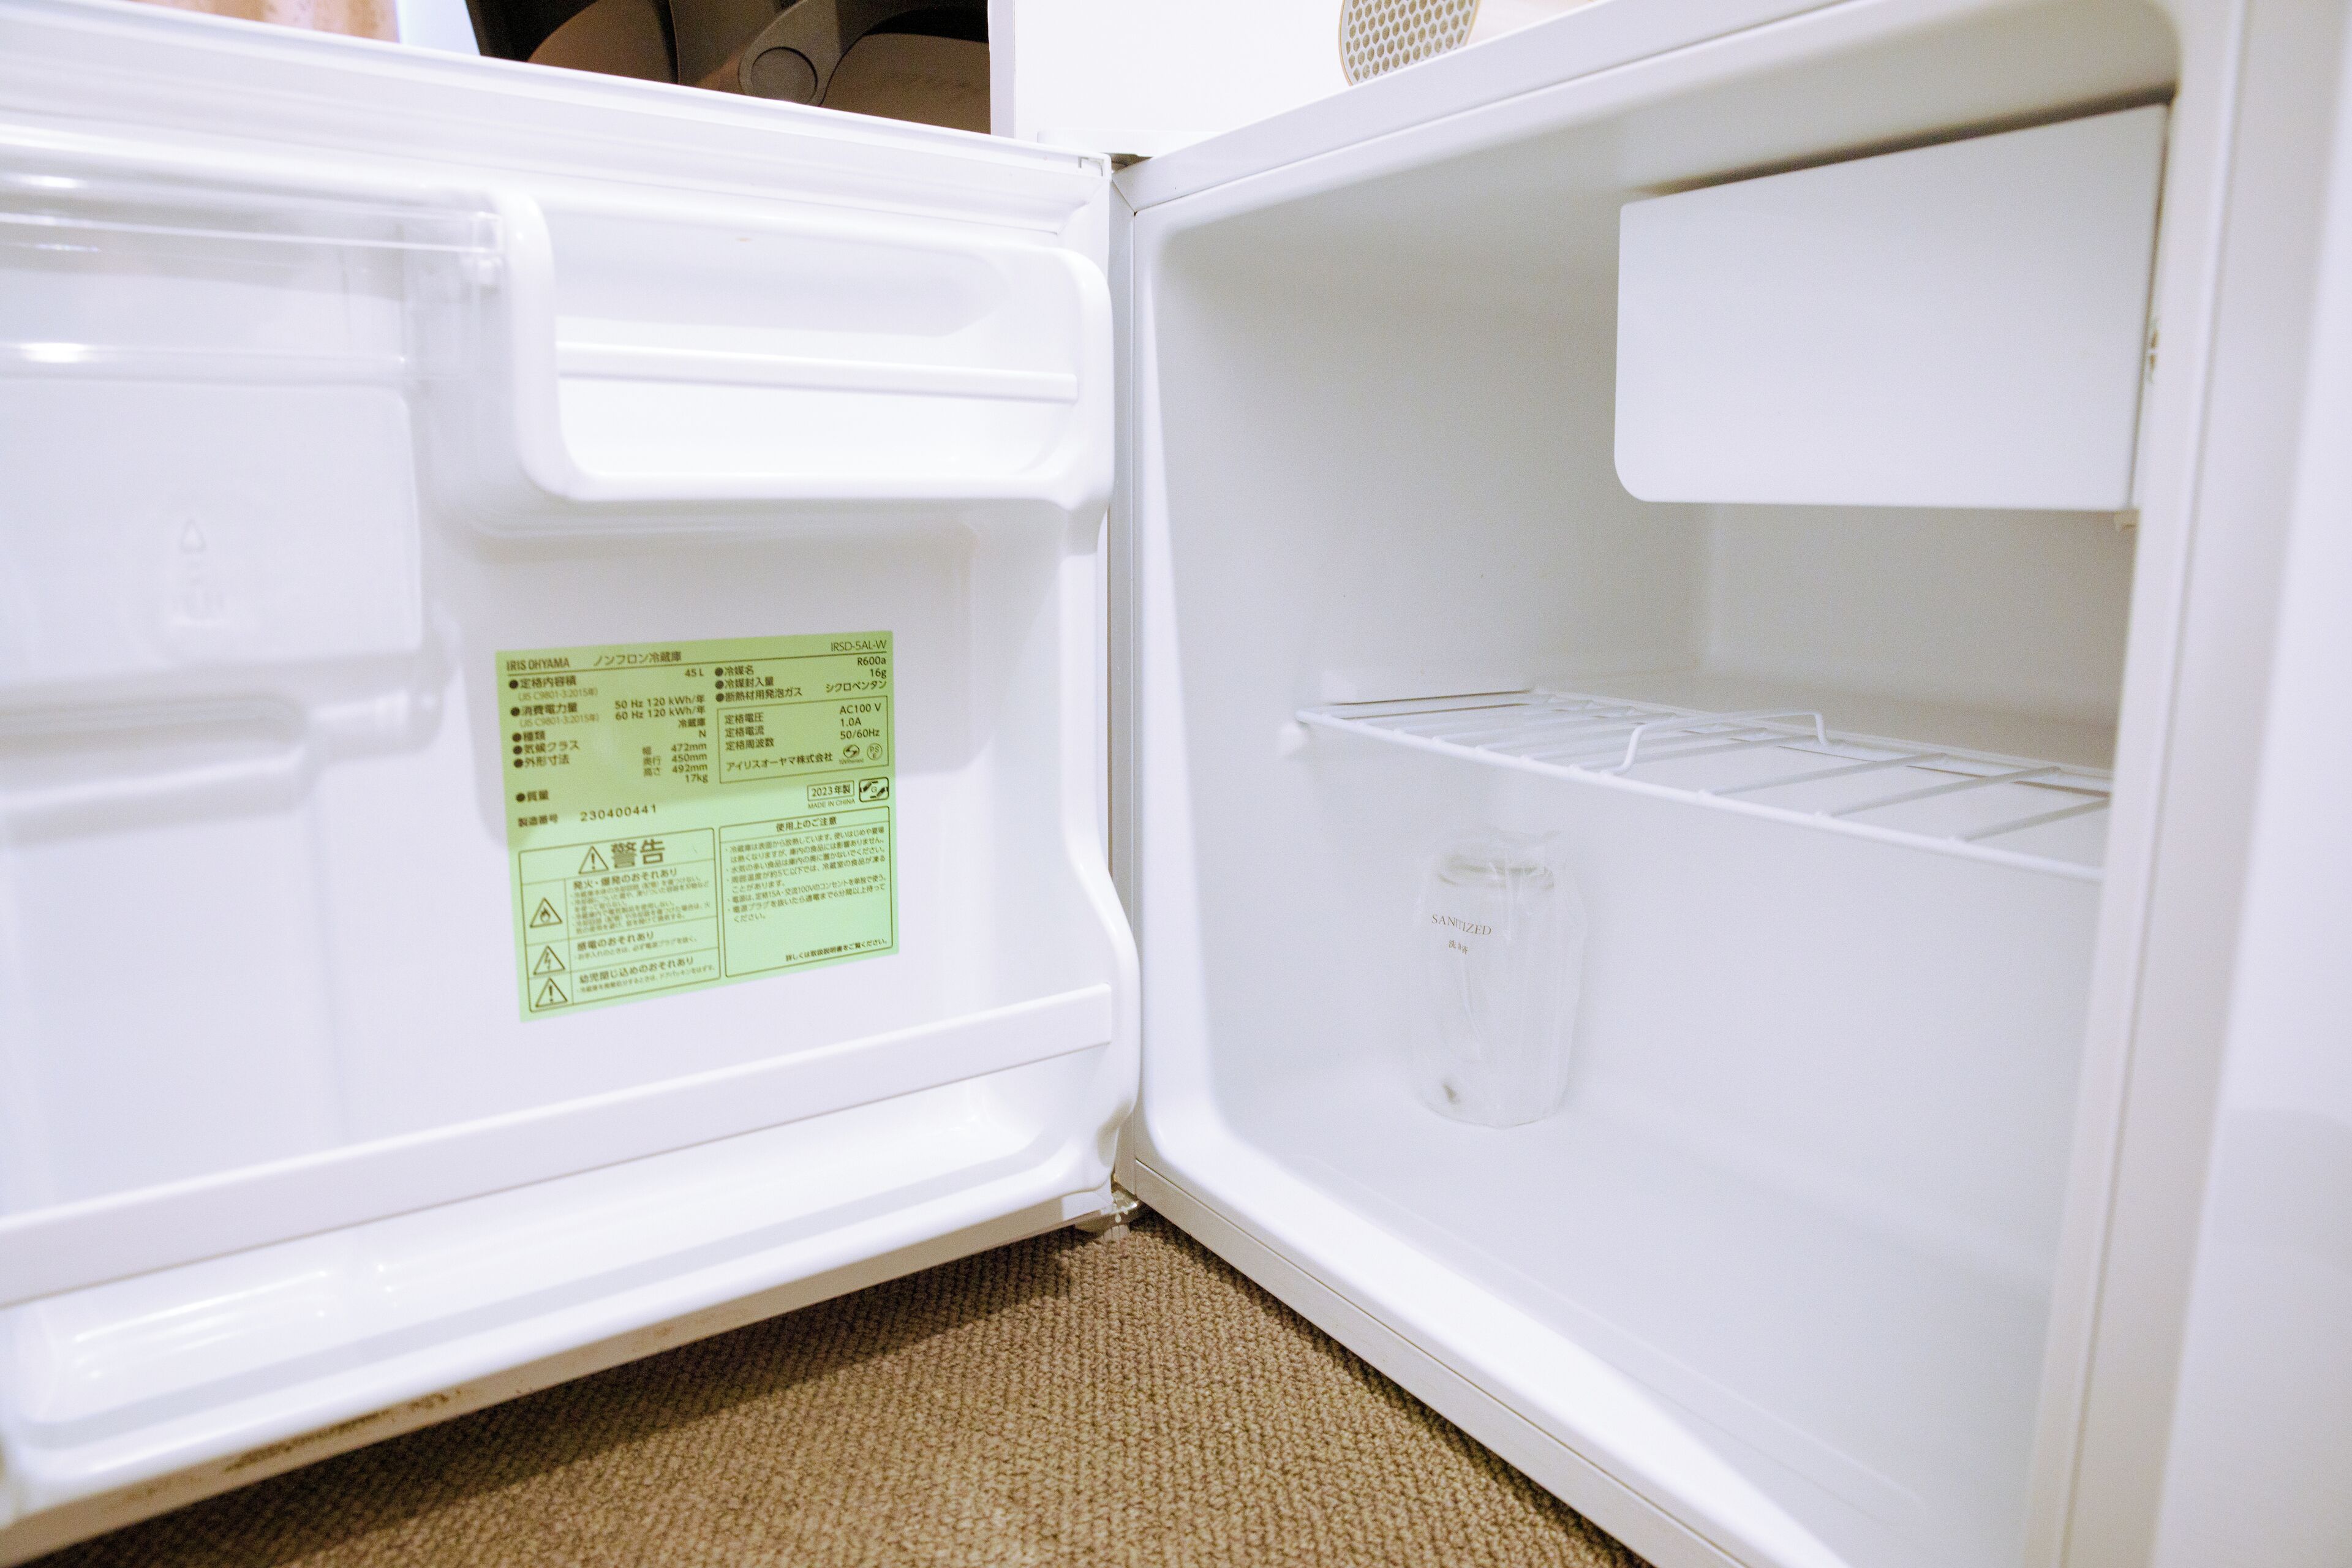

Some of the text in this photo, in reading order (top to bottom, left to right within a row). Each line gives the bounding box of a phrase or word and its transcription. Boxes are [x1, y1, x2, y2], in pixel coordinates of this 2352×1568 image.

[831, 639, 886, 651] IRSD-5AL-W
[507, 657, 569, 671] IRIS OHYAMA
[594, 651, 681, 666] ノンフロン冷蔵庫
[858, 656, 886, 665] R600a
[725, 665, 753, 676] 冷媒名
[870, 668, 886, 679] 16g
[519, 676, 576, 688] 定格内容積
[725, 676, 774, 688] 冷媒封入量
[826, 680, 886, 693] シクロペンタン
[725, 687, 802, 701] 断熱材用発泡ガス
[614, 694, 704, 709] 50 Hz 120 kWh/年
[522, 702, 577, 715] 消費電力量
[615, 704, 705, 720] 60 Hz 120 kWh/年
[840, 704, 870, 714] AC100
[679, 717, 706, 728] 冷蔵庫
[725, 712, 764, 725] 定格電圧
[841, 717, 861, 726] 1.0A
[523, 730, 545, 742] 種類
[725, 725, 764, 738] 定格電流
[840, 728, 880, 739] 50/60Hz
[524, 740, 579, 754] 気候クラス
[671, 742, 706, 752] 472mm
[725, 737, 774, 751] 定格周波数
[525, 753, 569, 767] 外形寸法
[671, 752, 707, 763] 450mm
[727, 752, 832, 772] アイリスオーヤマ株式会社
[672, 763, 707, 774] 492mm
[685, 773, 708, 785] 17kg
[527, 789, 549, 801] 質量
[811, 784, 850, 797] 2023年製
[580, 804, 656, 821] 230400441
[518, 814, 557, 827] 製造番号
[776, 816, 836, 832] 使用上のご注意
[611, 837, 665, 869] 警告
[577, 930, 654, 951] 感電のおそれあり
